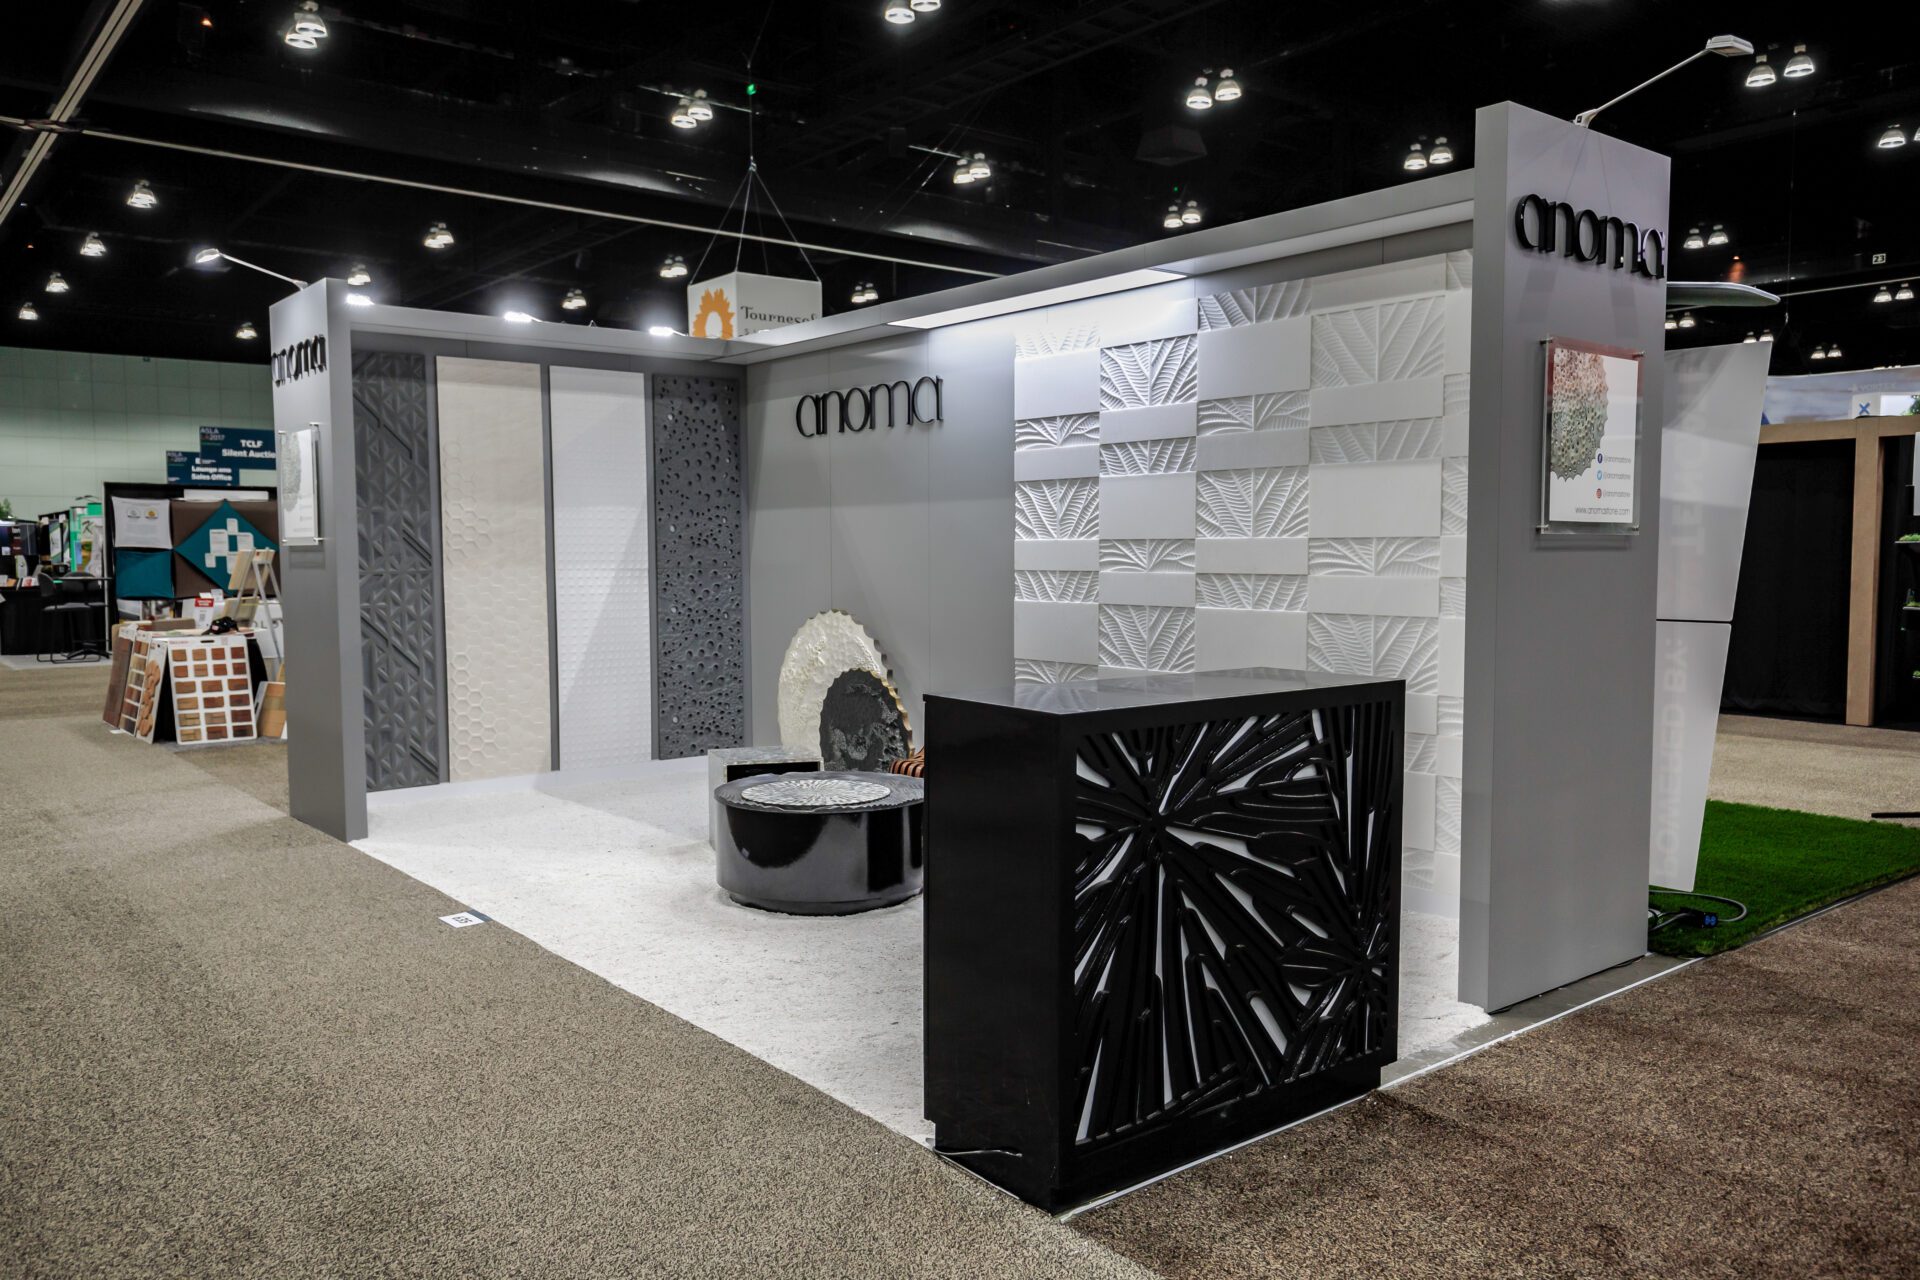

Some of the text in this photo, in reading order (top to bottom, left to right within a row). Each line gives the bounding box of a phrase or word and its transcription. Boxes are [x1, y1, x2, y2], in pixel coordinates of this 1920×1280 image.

[1515, 194, 1665, 279] anoma
[740, 306, 818, 324] Tournes
[270, 334, 327, 388] anoma
[796, 375, 943, 437] anoma
[222, 448, 247, 457] Silent
[240, 440, 264, 448] TCLF
